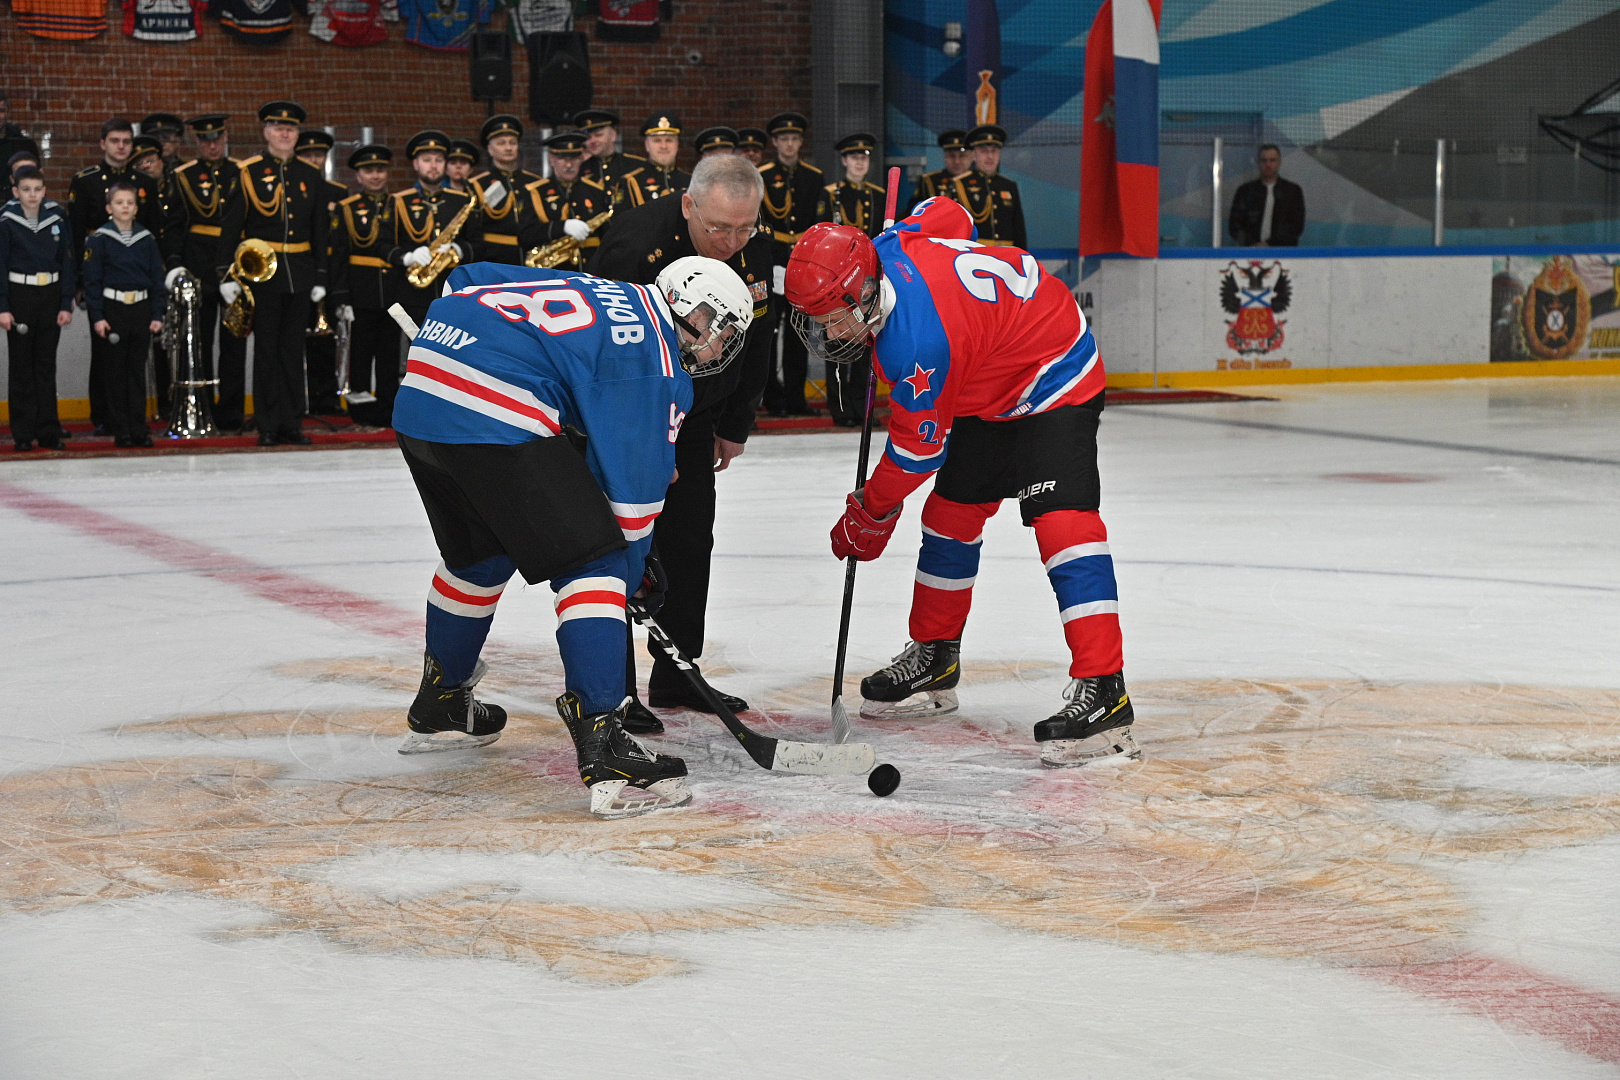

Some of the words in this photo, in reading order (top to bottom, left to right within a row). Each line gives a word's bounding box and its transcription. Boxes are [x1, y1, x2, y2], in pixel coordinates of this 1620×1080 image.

[567, 275, 645, 346] ЕЧНОВ
[707, 293, 728, 309] CCM
[418, 318, 479, 350] НВМУ
[1017, 480, 1057, 502] AUER
